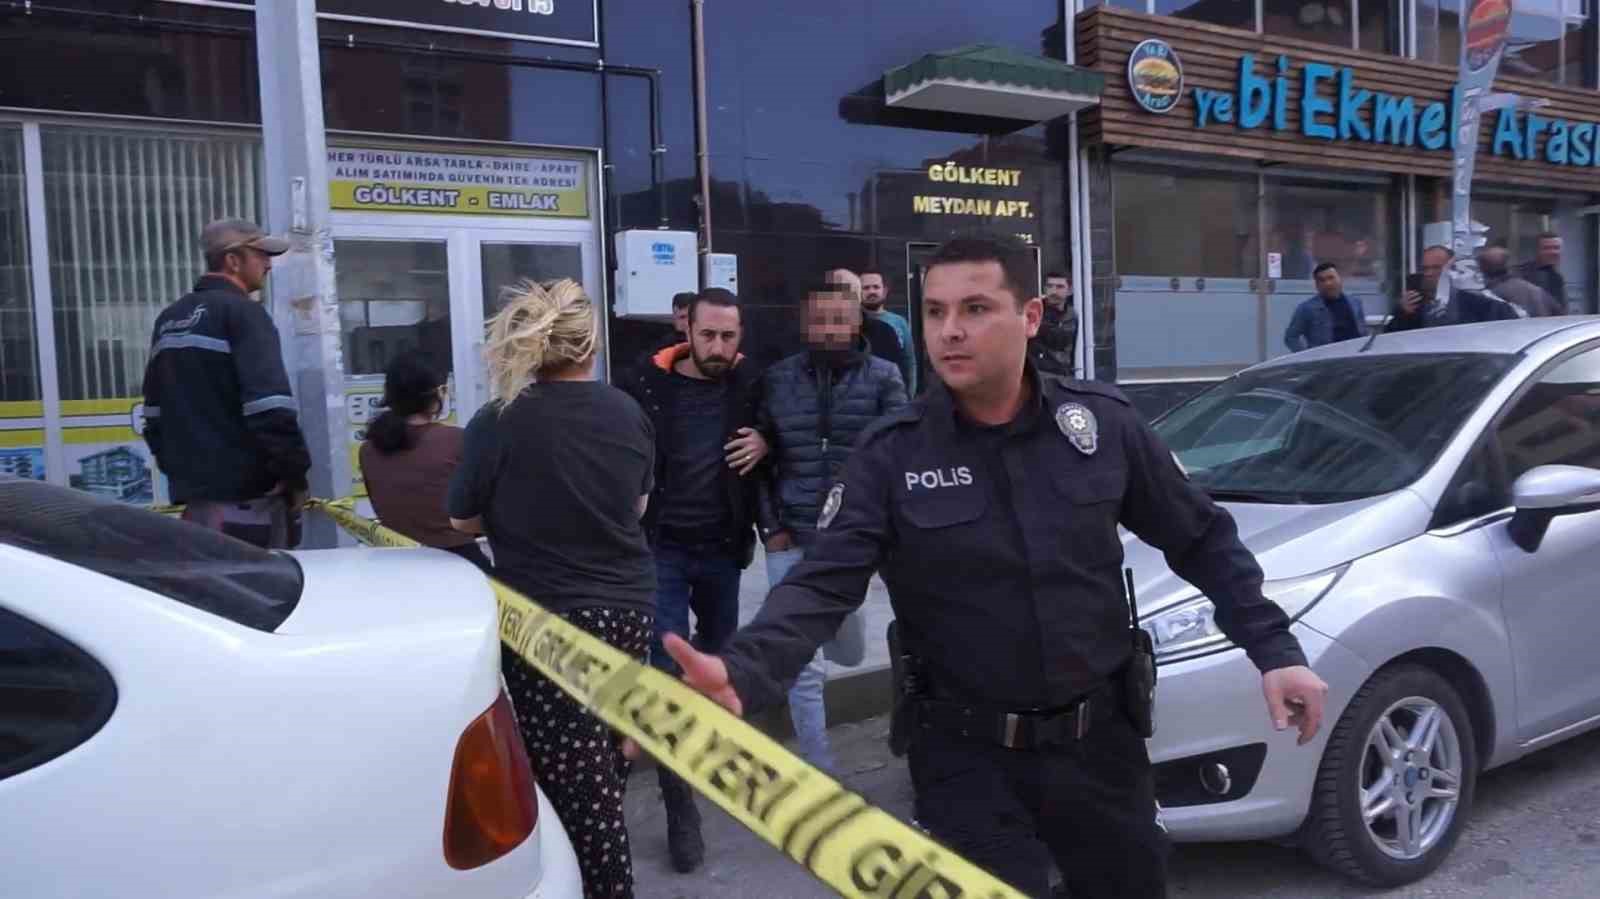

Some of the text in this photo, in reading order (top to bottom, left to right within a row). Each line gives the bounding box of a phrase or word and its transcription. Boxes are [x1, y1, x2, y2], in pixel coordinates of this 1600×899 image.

[928, 161, 1021, 187] GÖLKENT
[353, 182, 459, 207] GÖLKENT
[487, 191, 560, 211] EMLAK
[912, 196, 1035, 218] MEYDAN APT.
